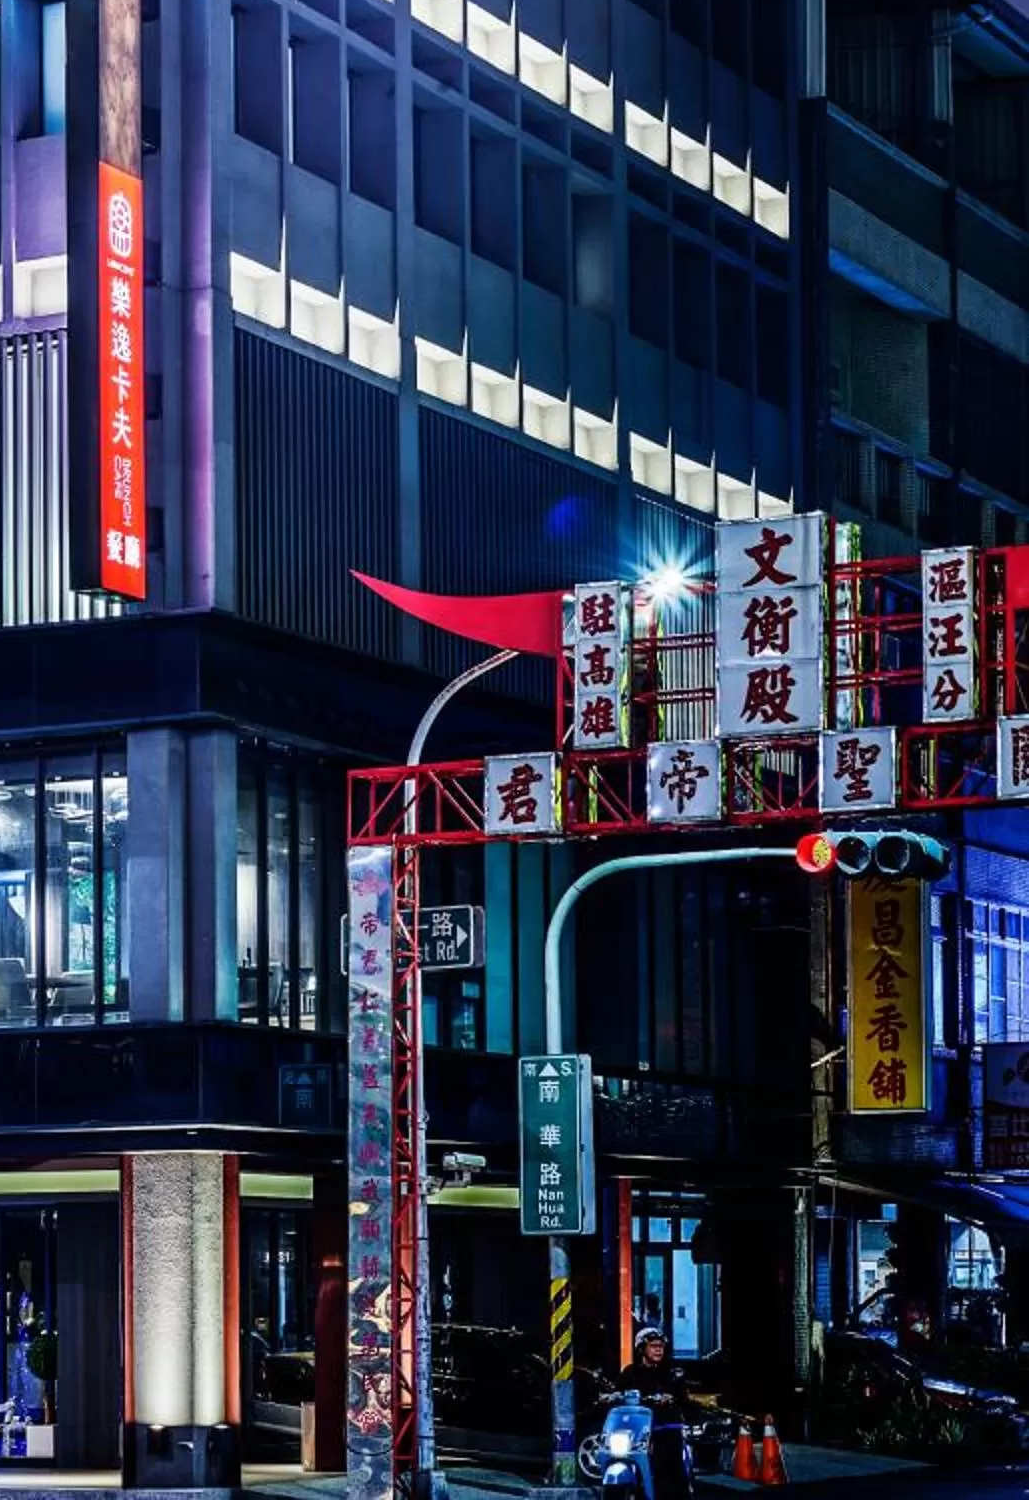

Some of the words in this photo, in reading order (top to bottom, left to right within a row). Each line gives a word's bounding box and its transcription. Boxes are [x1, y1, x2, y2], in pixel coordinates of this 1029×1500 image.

[740, 527, 799, 724] 文衡殿
[929, 558, 968, 712] 漚汪分
[580, 593, 616, 738] 駐高雄
[436, 940, 460, 961] Rd.
[538, 1079, 562, 1187] 南華路
[538, 1189, 564, 1201] Nan
[538, 1202, 564, 1215] Hua
[540, 1215, 562, 1228] Rd.
